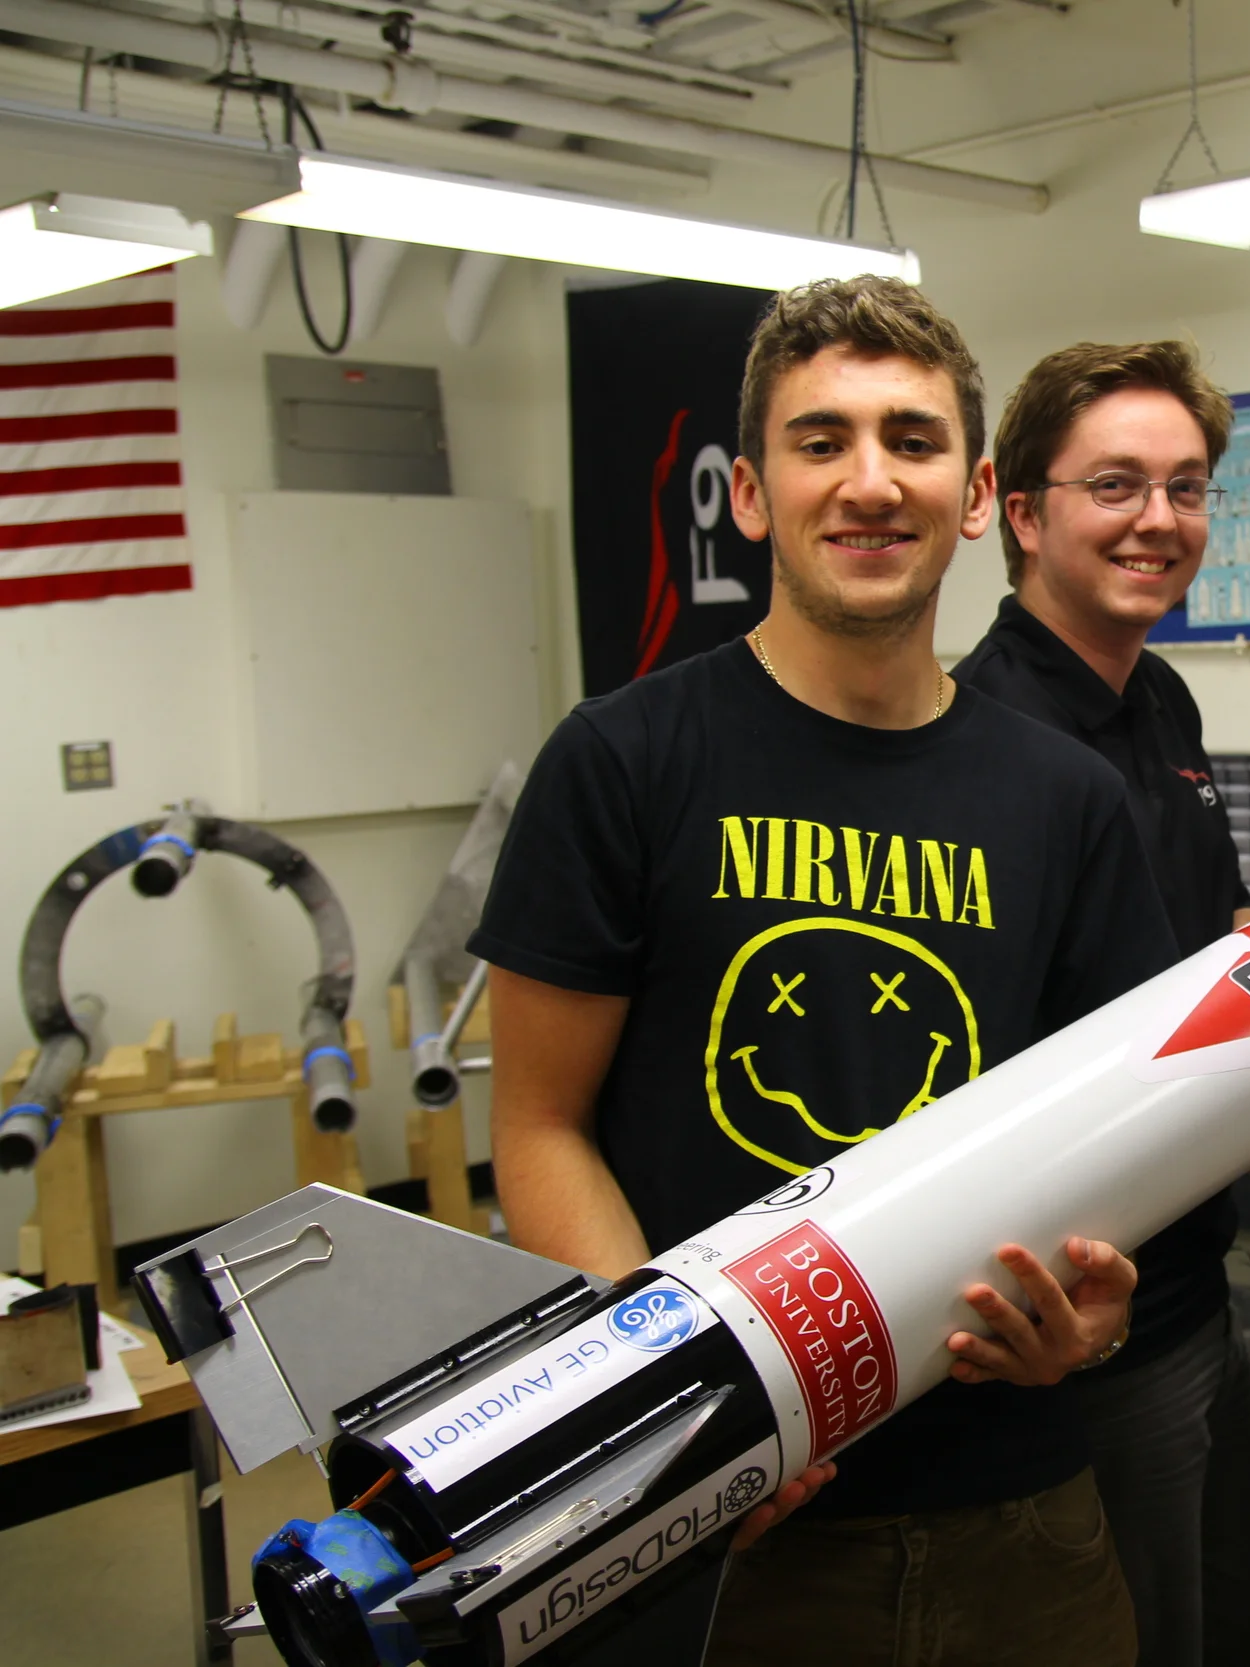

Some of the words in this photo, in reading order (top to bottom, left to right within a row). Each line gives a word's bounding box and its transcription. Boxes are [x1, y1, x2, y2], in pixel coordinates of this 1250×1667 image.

[711, 816, 996, 930] NIRVANA
[556, 1339, 609, 1379] GE
[754, 1261, 846, 1440] UNIVERSITY
[780, 1239, 882, 1424] BOSTON
[408, 1366, 555, 1460] Aviation
[519, 1492, 722, 1645] FloDesign
